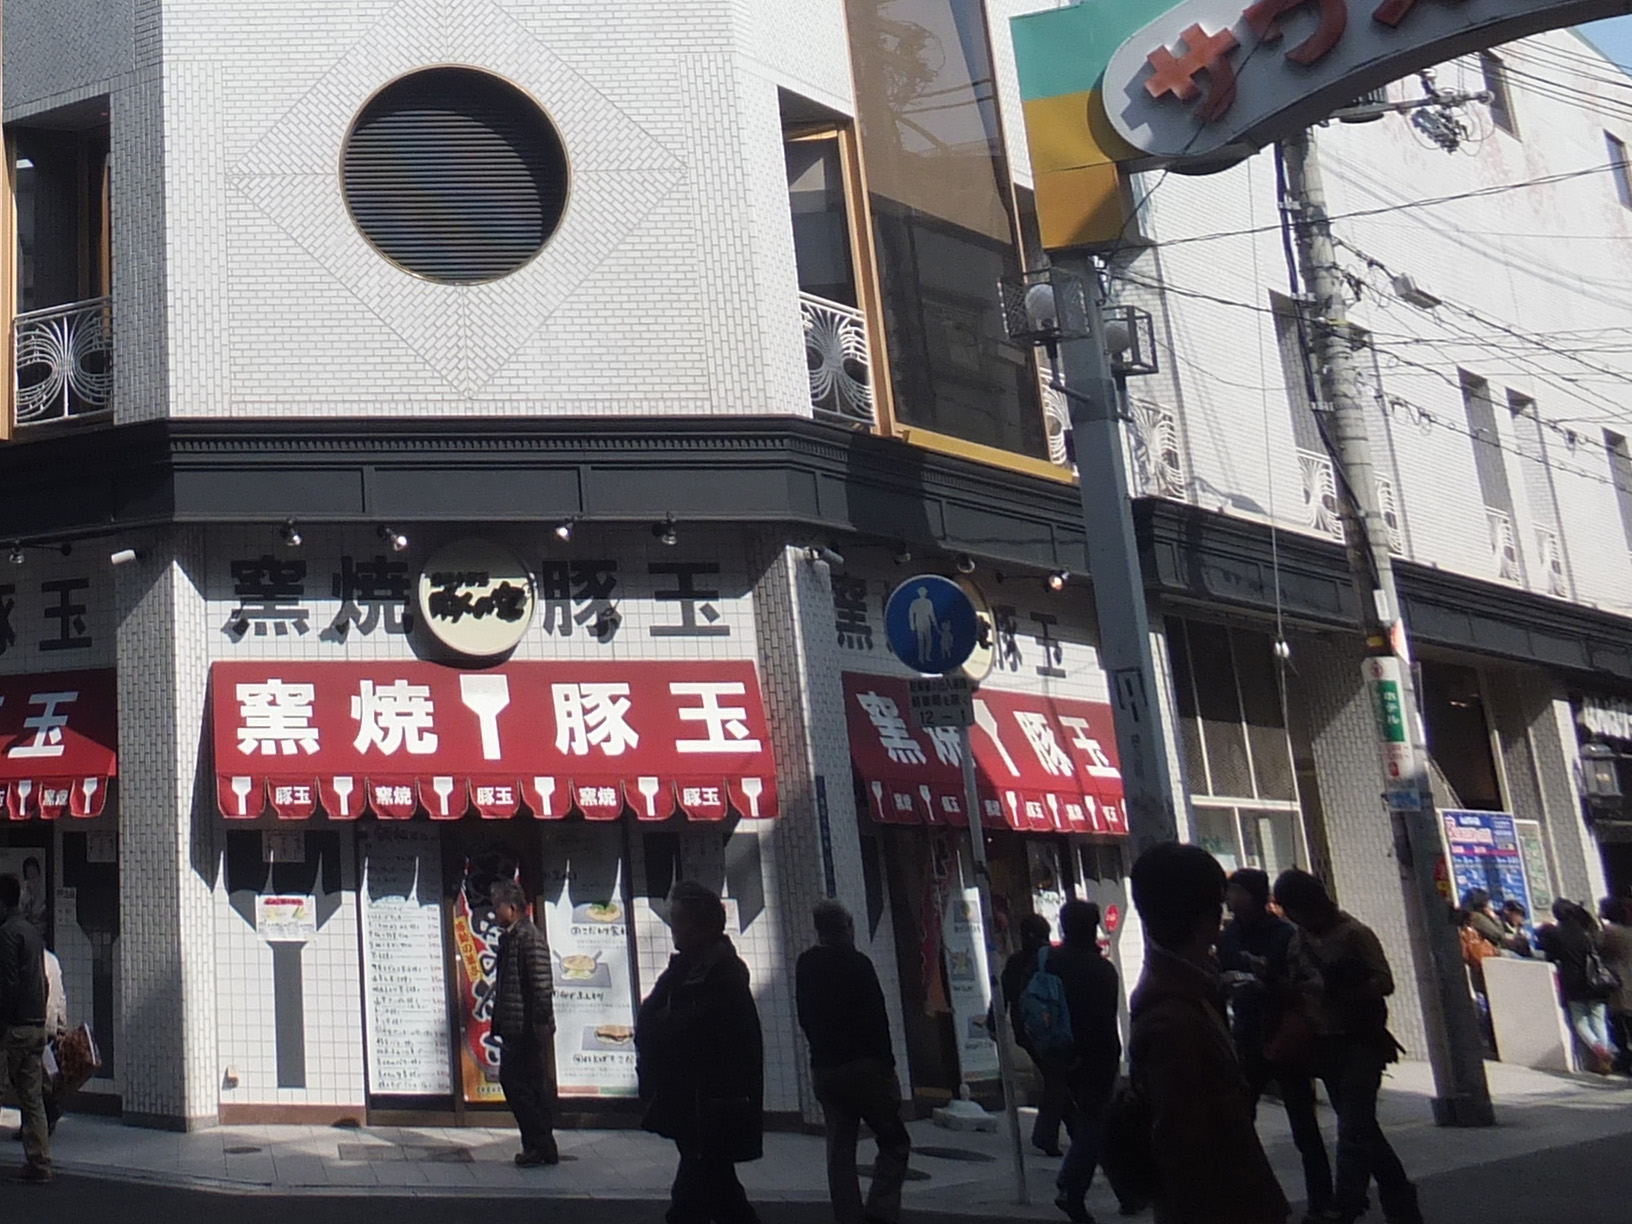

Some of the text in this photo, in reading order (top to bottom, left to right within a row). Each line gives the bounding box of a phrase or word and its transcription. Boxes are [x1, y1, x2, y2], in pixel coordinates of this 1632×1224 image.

[231, 559, 412, 636] 窯焼
[542, 559, 731, 637] 豚玉
[235, 680, 762, 756] 窯焼 豚玉
[275, 786, 721, 806] 豚玉 窯焼 豚玉 窯焼 豚玉
